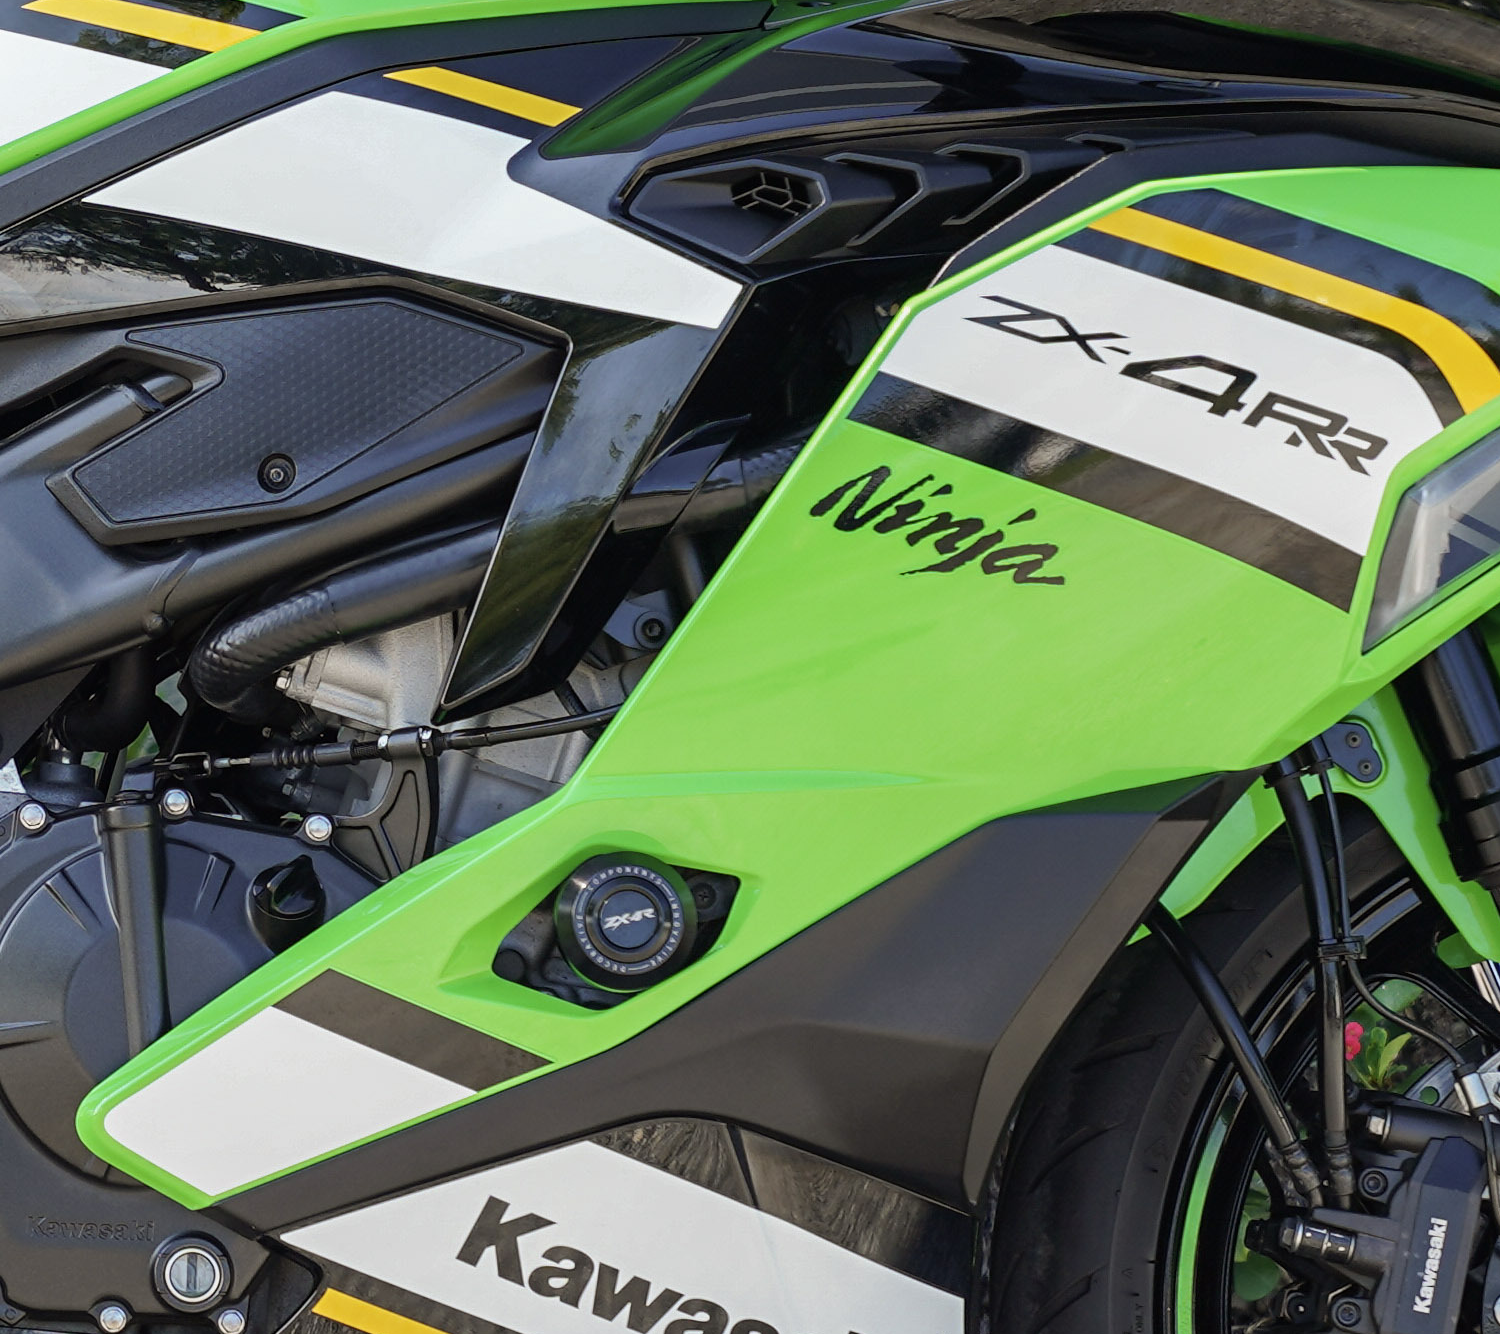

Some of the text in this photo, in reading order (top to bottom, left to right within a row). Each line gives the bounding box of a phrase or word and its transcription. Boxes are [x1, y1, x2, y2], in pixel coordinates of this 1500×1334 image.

[964, 295, 1388, 476] ZX-4RR
[809, 465, 1066, 586] Ninja
[27, 1216, 155, 1242] Kawasaki
[1412, 1217, 1450, 1314] Kawasaki
